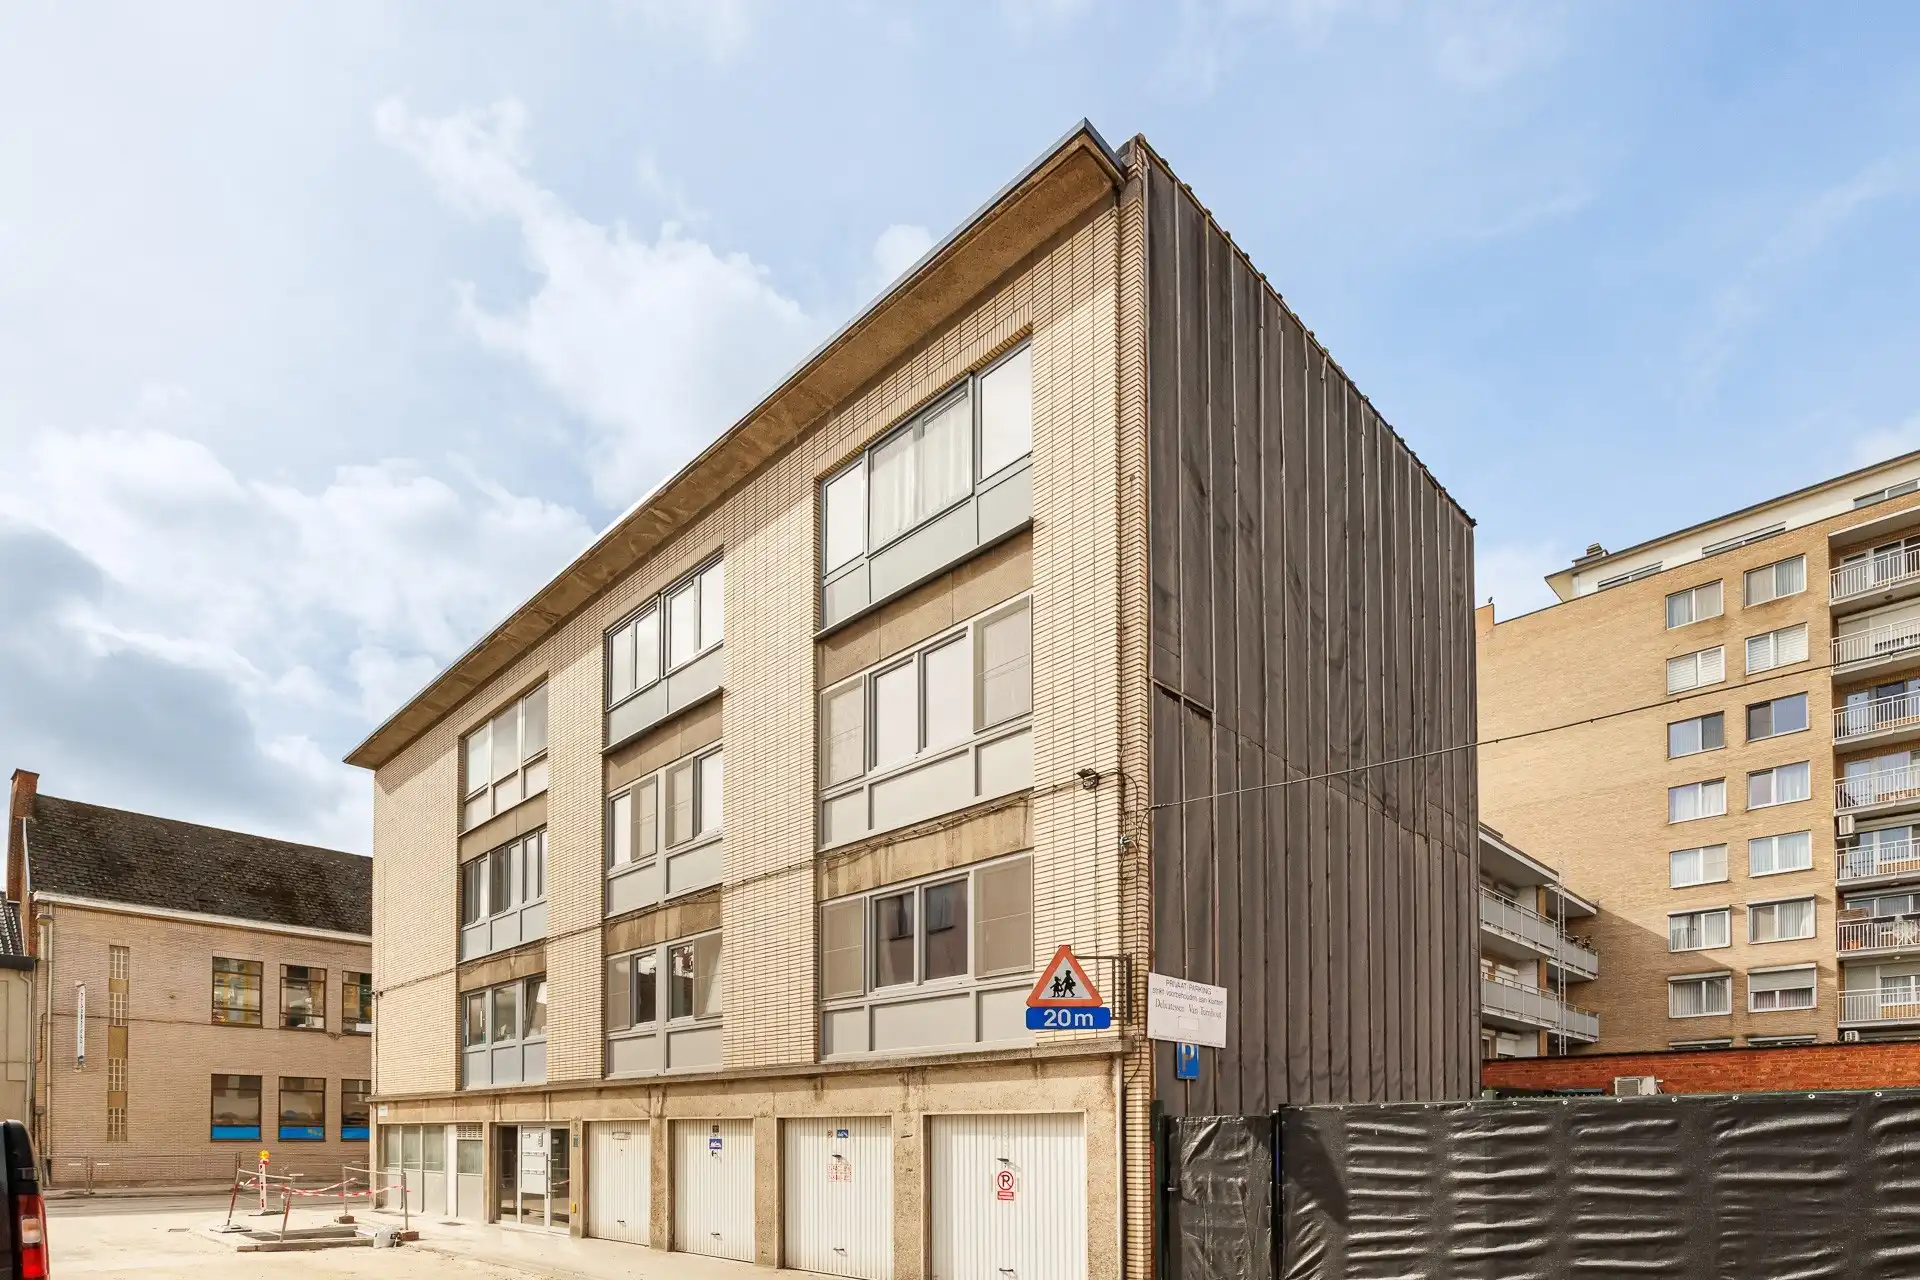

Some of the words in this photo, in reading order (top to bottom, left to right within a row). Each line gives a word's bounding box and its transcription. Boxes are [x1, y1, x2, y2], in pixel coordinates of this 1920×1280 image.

[1166, 979, 1187, 990] PRIVAAT
[1189, 984, 1212, 995] PARKING
[1043, 1008, 1072, 1027] 20
[1074, 1013, 1094, 1027] m
[1189, 1004, 1199, 1014] Van
[1182, 1043, 1195, 1072] P
